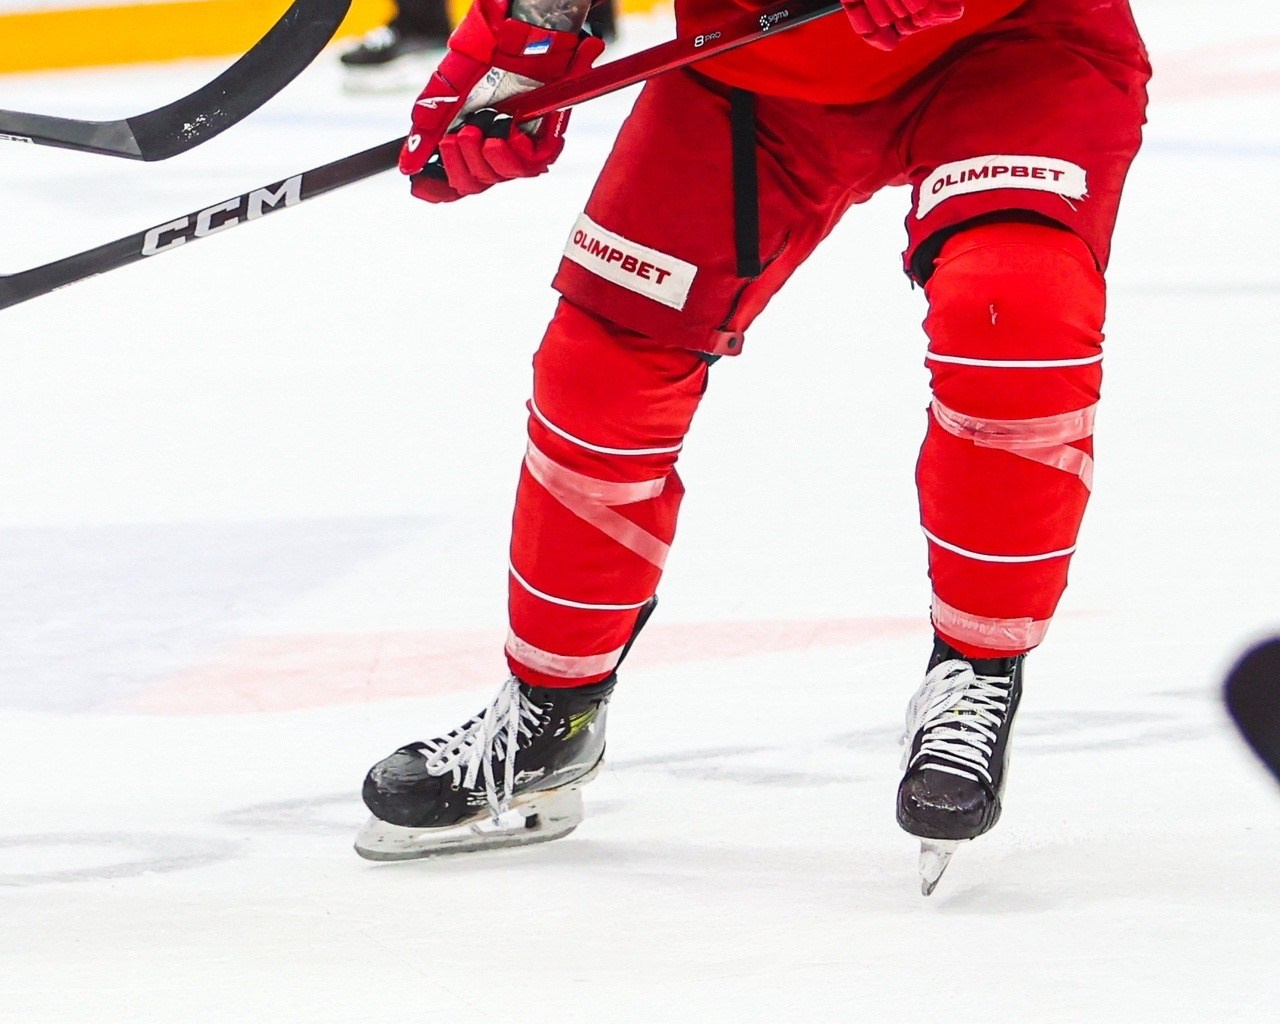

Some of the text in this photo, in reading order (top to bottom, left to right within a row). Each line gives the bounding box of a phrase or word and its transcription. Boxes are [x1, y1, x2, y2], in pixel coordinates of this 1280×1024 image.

[931, 166, 1065, 195] OLIMPBET
[141, 175, 303, 256] CCM
[573, 229, 672, 285] OLIMPBET
